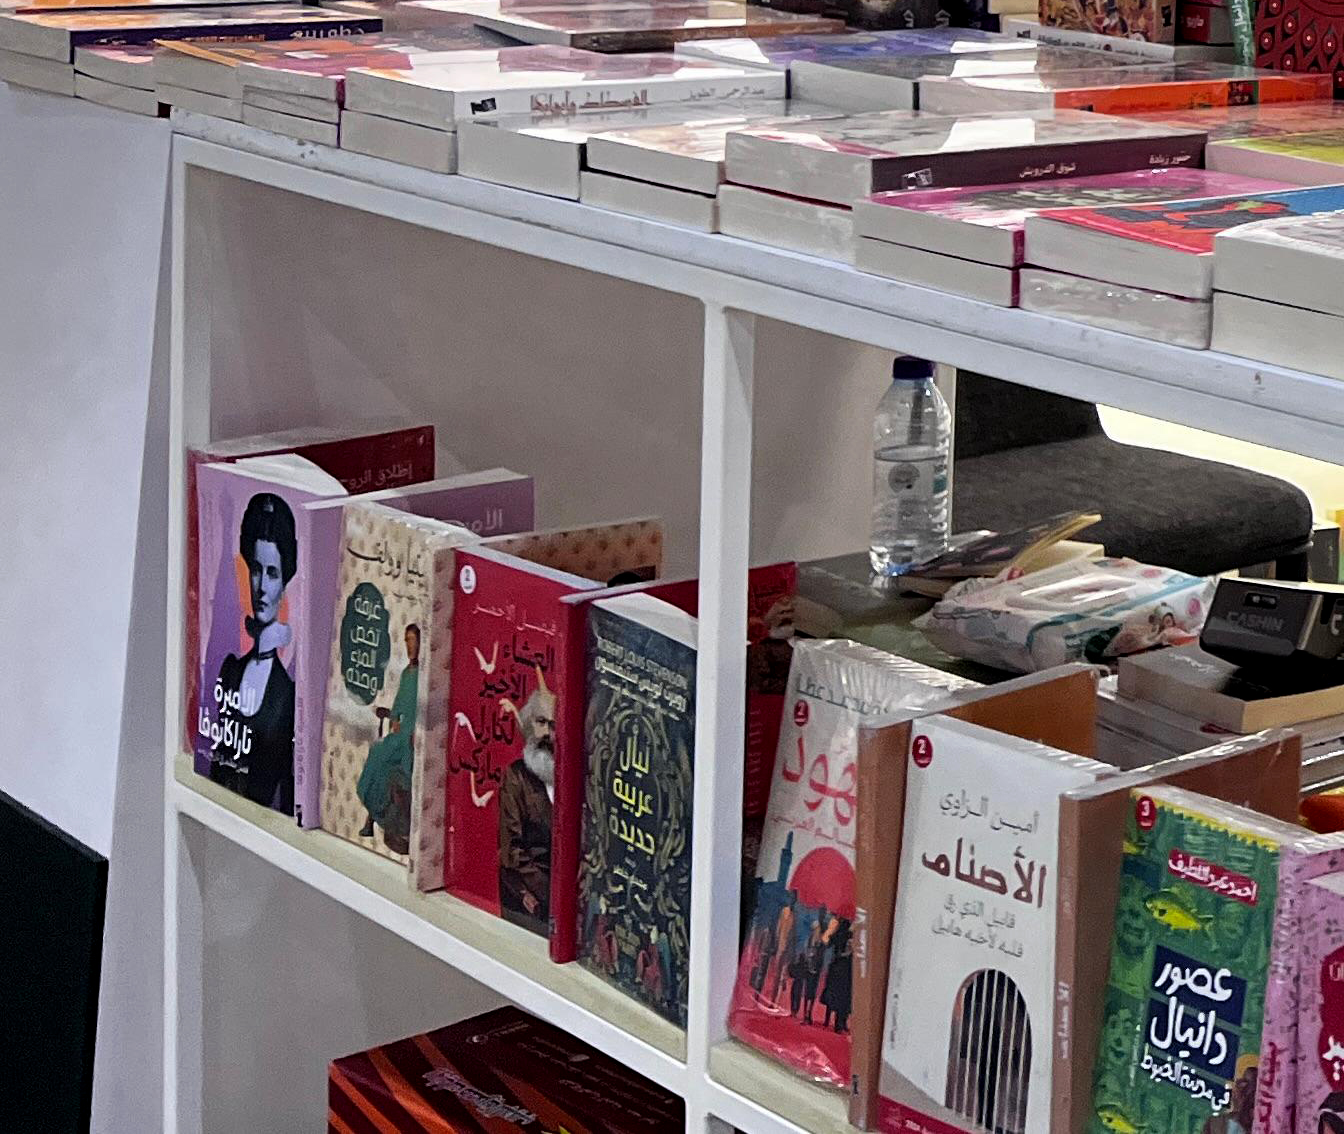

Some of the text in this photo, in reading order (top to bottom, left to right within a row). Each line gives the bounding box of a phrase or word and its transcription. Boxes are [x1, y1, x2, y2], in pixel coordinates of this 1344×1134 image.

[354, 594, 382, 621] غرفة
[1225, 610, 1284, 635] CASHIN
[916, 739, 928, 759] 2
[1140, 801, 1151, 819] 3
[921, 836, 1046, 909] الأصنام
[1155, 962, 1233, 1001] عصور
[1150, 996, 1228, 1064] دانيال
